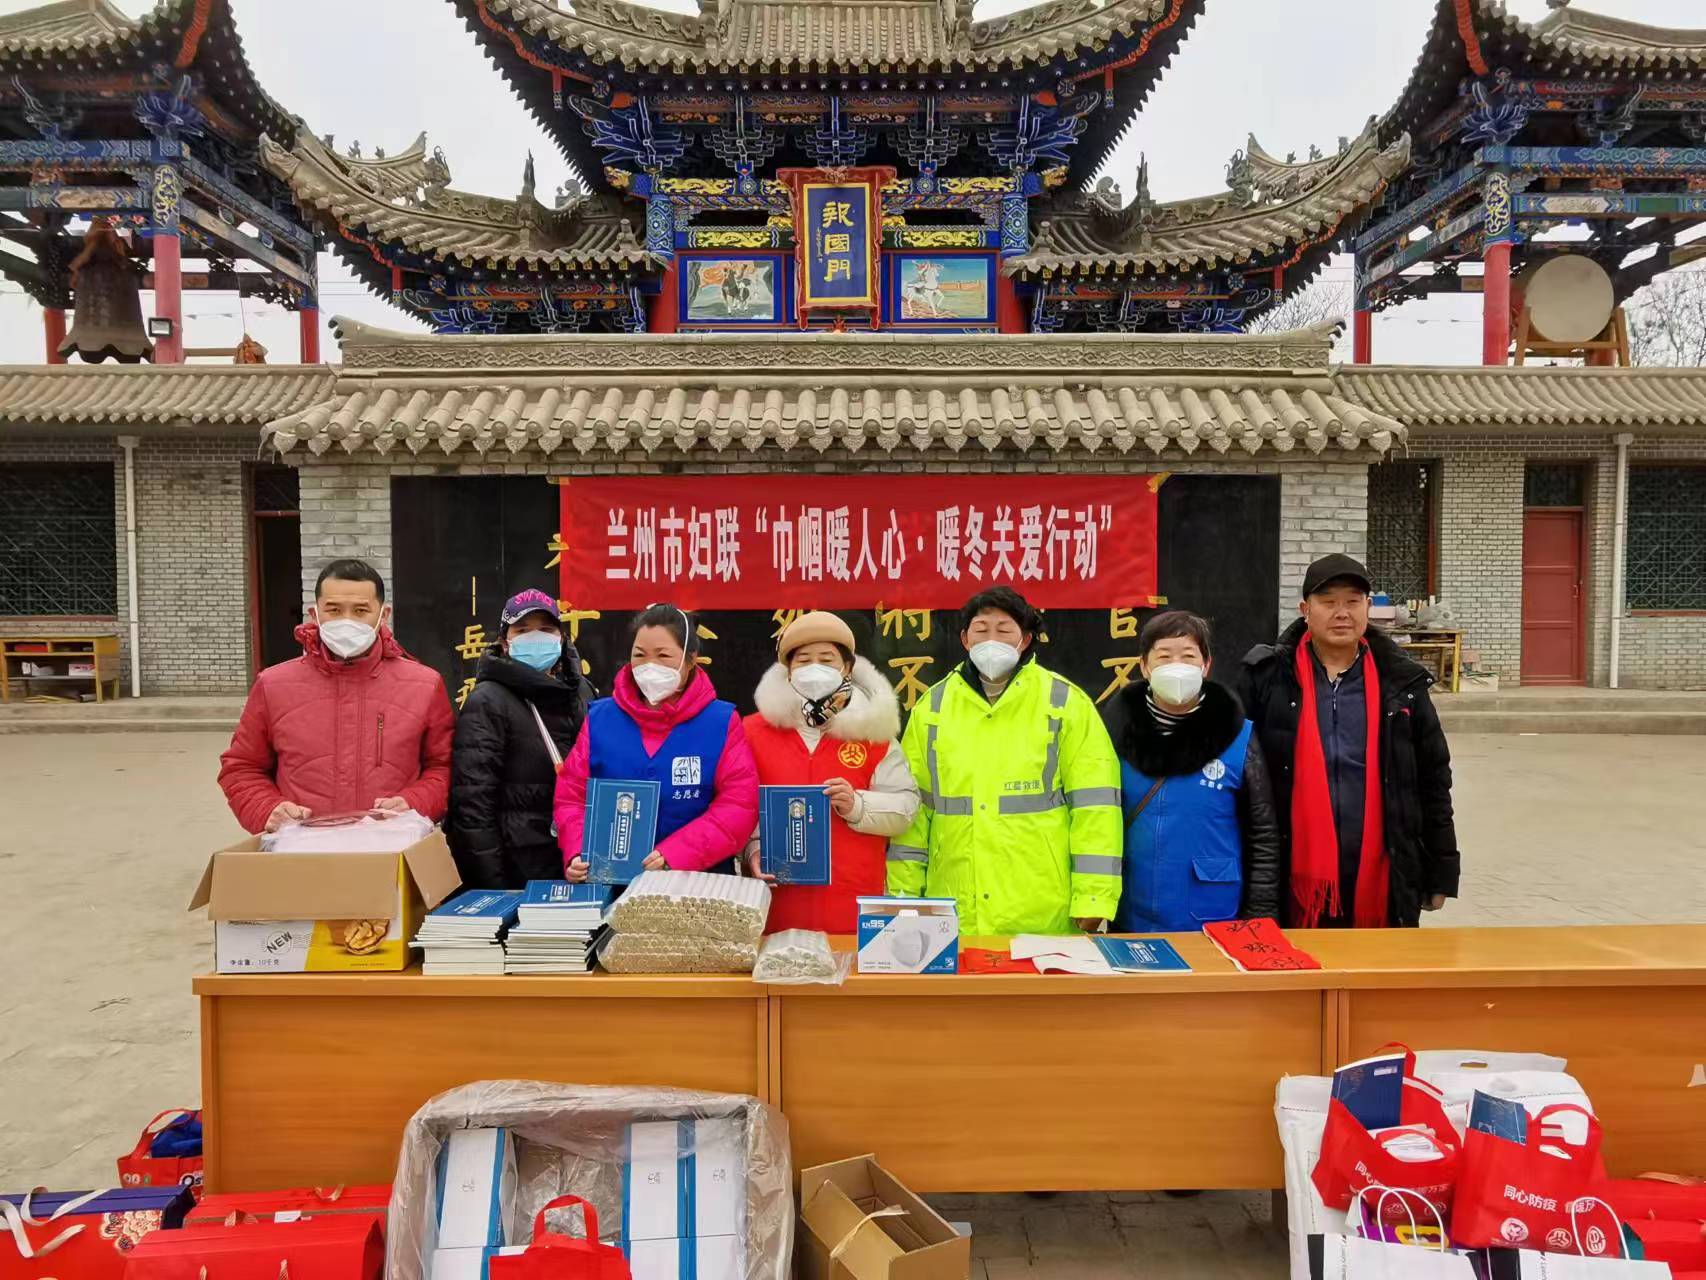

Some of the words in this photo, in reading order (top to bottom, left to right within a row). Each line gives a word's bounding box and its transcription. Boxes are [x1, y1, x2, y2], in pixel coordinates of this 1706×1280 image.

[267, 931, 293, 954] NEW
[1504, 1184, 1558, 1212] 同心防疫
